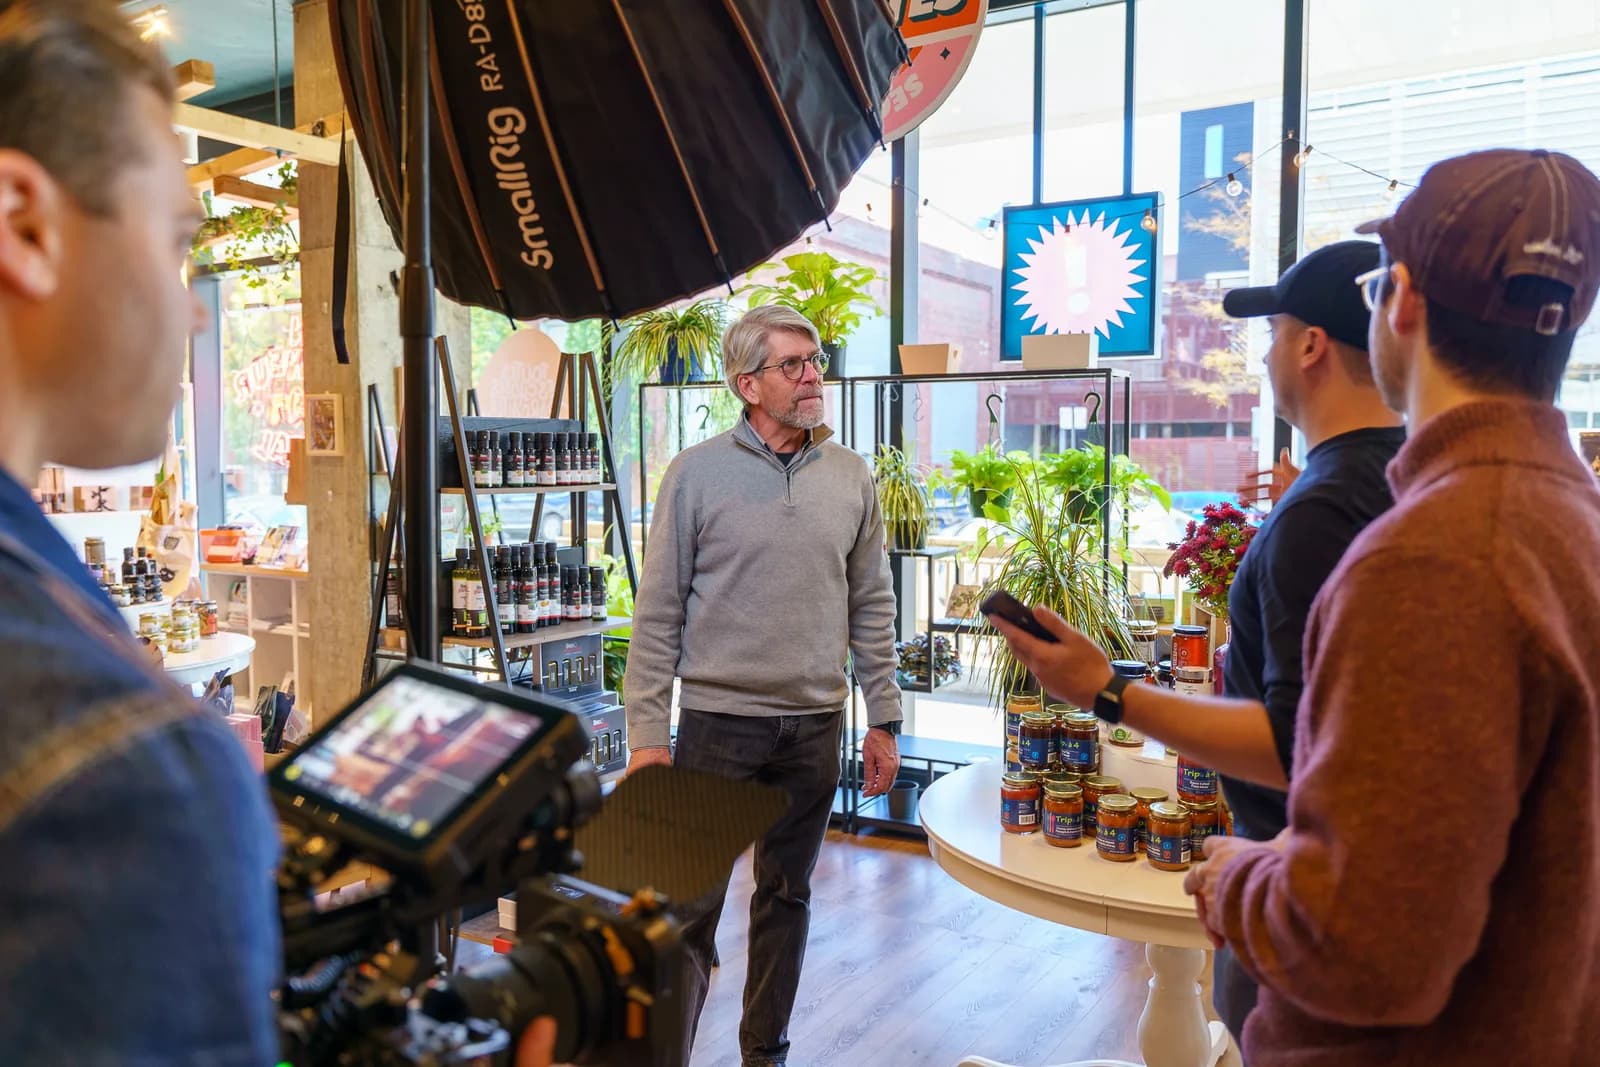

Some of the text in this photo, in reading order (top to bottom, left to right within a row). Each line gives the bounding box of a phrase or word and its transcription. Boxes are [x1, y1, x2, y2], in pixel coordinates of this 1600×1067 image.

[465, 0, 554, 270] SmallRig RA-D8
[1055, 815, 1073, 825] Trip
